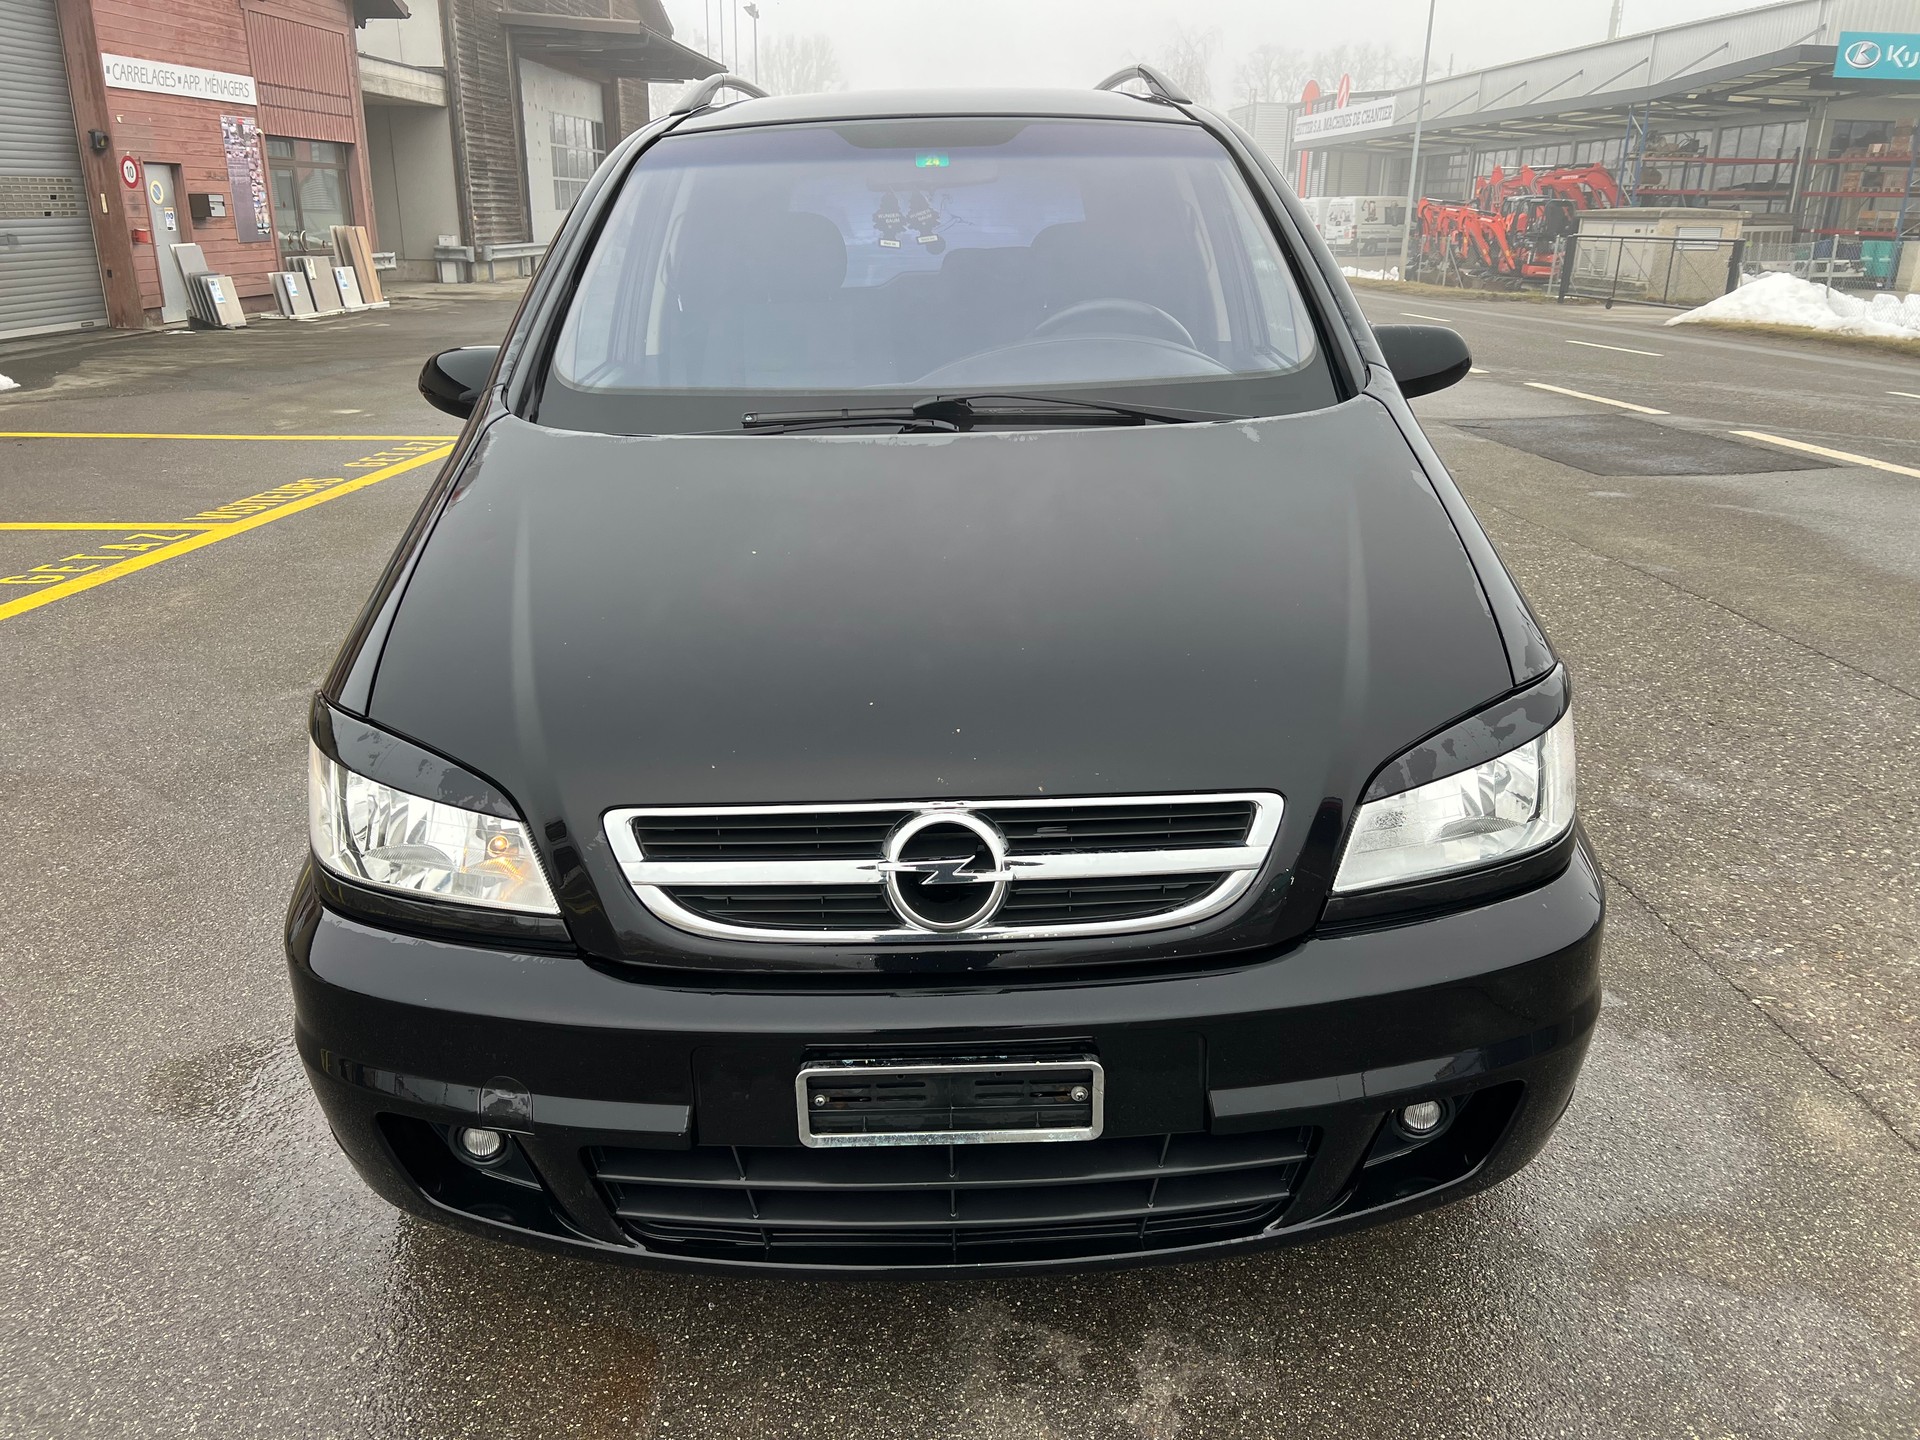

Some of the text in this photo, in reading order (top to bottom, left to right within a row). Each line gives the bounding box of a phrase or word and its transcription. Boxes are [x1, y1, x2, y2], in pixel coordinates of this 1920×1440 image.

[112, 63, 250, 98] CARRELAGES APP. MÉNAGERS
[1323, 112, 1352, 131] MACHINES
[1352, 111, 1362, 126] DE
[1362, 104, 1393, 125] CHANTIER
[126, 166, 135, 178] 10
[344, 441, 449, 468] GETAZ
[183, 477, 345, 521] VISITEURS
[0, 533, 190, 584] GETAZ
